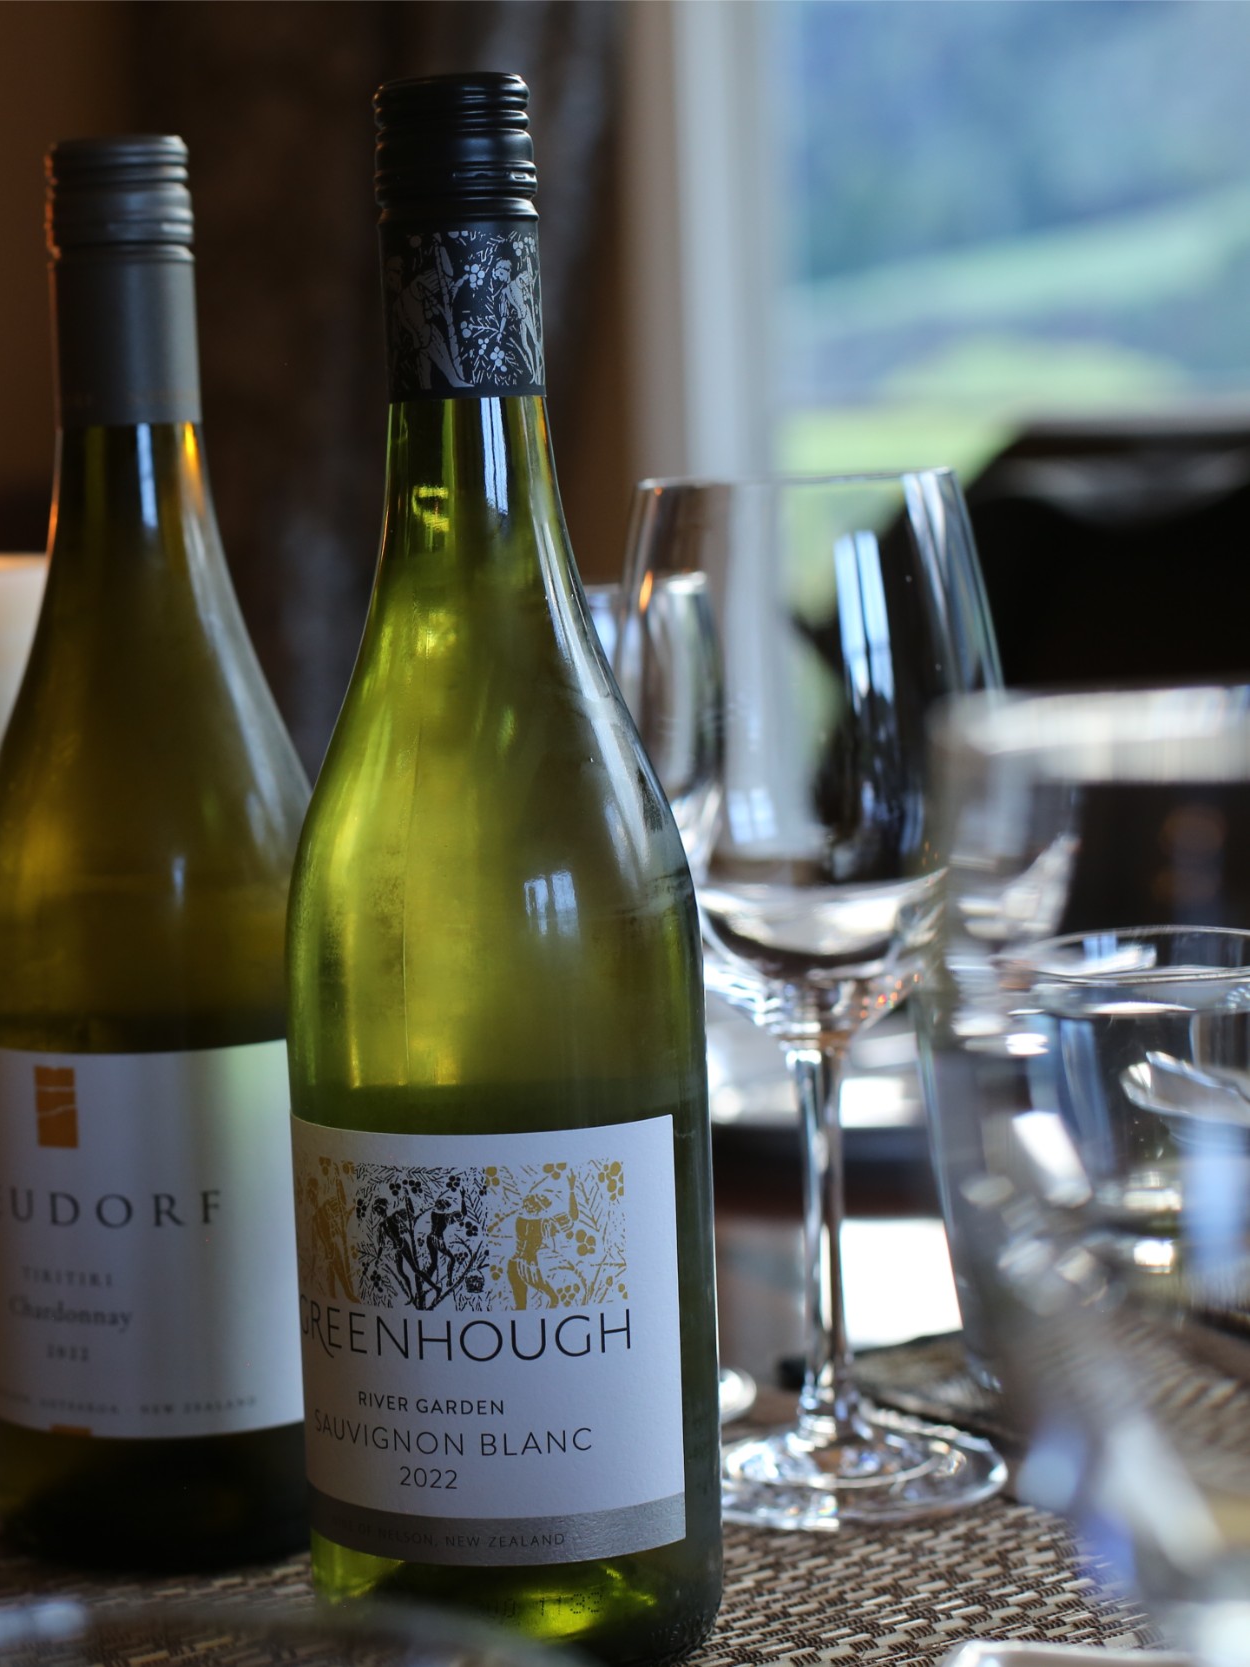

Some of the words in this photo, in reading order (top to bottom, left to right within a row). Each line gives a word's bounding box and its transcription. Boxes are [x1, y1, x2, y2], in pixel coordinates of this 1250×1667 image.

[300, 1294, 631, 1362] GREENHOUGH
[358, 1391, 408, 1413] RIVER
[416, 1398, 505, 1416] GARDEN
[314, 1409, 463, 1456] SAUVIGNON
[481, 1428, 592, 1457] BLANC
[400, 1466, 459, 1490] 2022
[445, 1534, 480, 1548] NEW
[488, 1532, 566, 1548] ZEALAND
